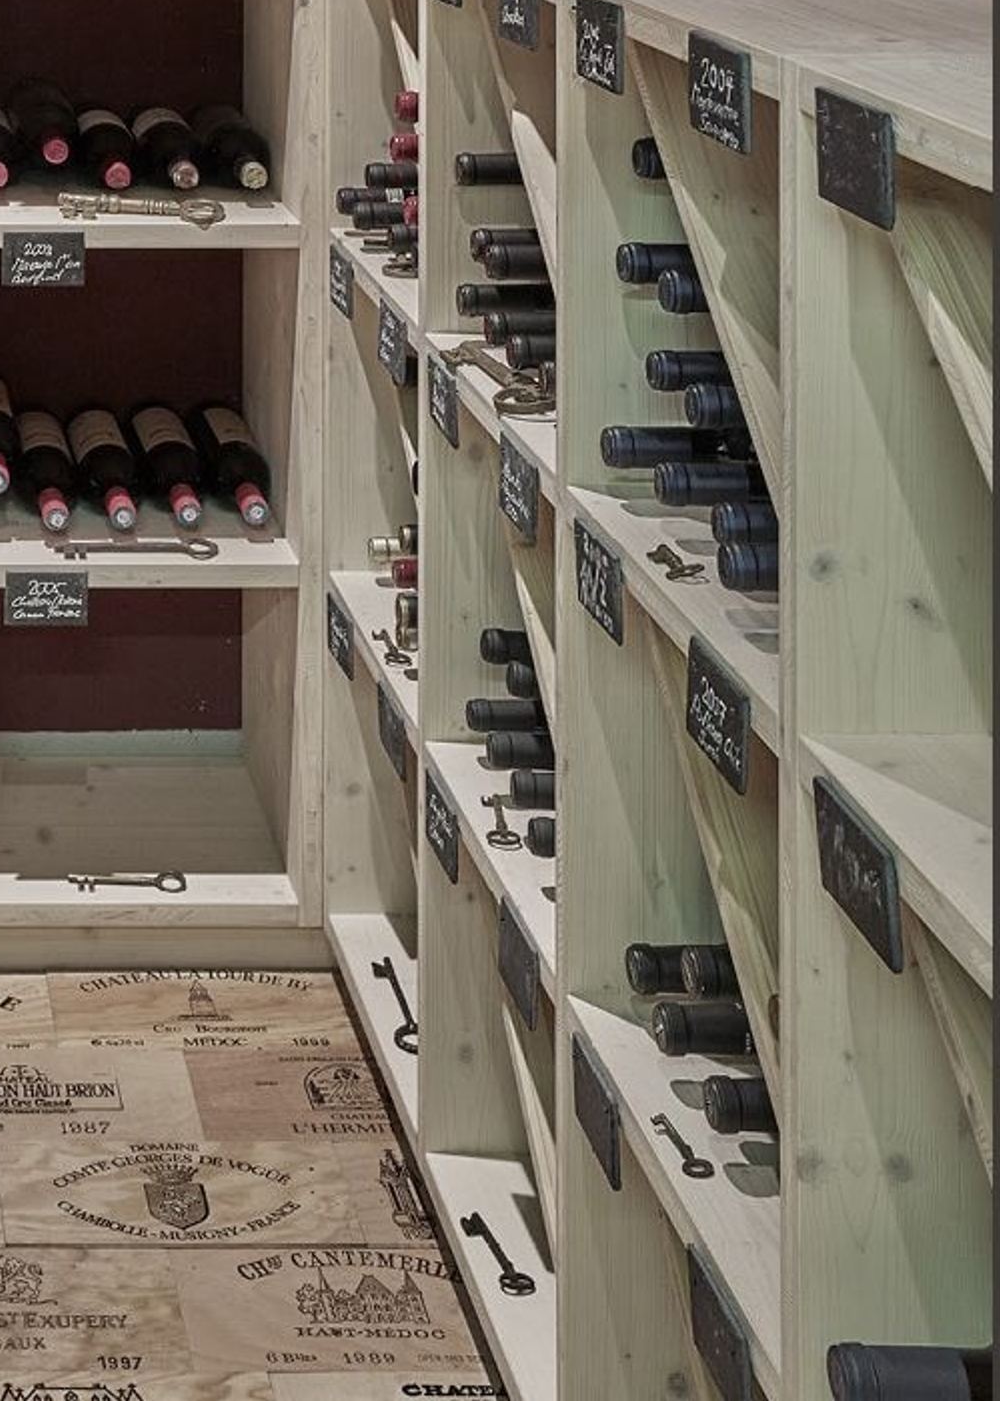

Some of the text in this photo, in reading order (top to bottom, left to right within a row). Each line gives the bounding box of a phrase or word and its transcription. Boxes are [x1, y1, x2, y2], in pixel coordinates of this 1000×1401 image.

[207, 969, 256, 982] TOUR
[258, 972, 284, 986] DE
[287, 978, 313, 992] BY
[22, 1083, 62, 1098] HAUT
[65, 1083, 116, 1098] BRION
[14, 1099, 33, 1109] Cru
[60, 1120, 111, 1135] 1987
[129, 1142, 200, 1153] DOMAINE
[52, 1160, 113, 1189] COMTE
[111, 1152, 193, 1170] GEORGES
[199, 1155, 224, 1168] DE
[56, 1199, 302, 1242] CHAMBOLLE MUSIGNY FRANCE
[21, 1311, 129, 1329] EXUPERY
[96, 1355, 144, 1370] 1997
[266, 1352, 280, 1364] 6
[342, 1352, 396, 1365] 1989
